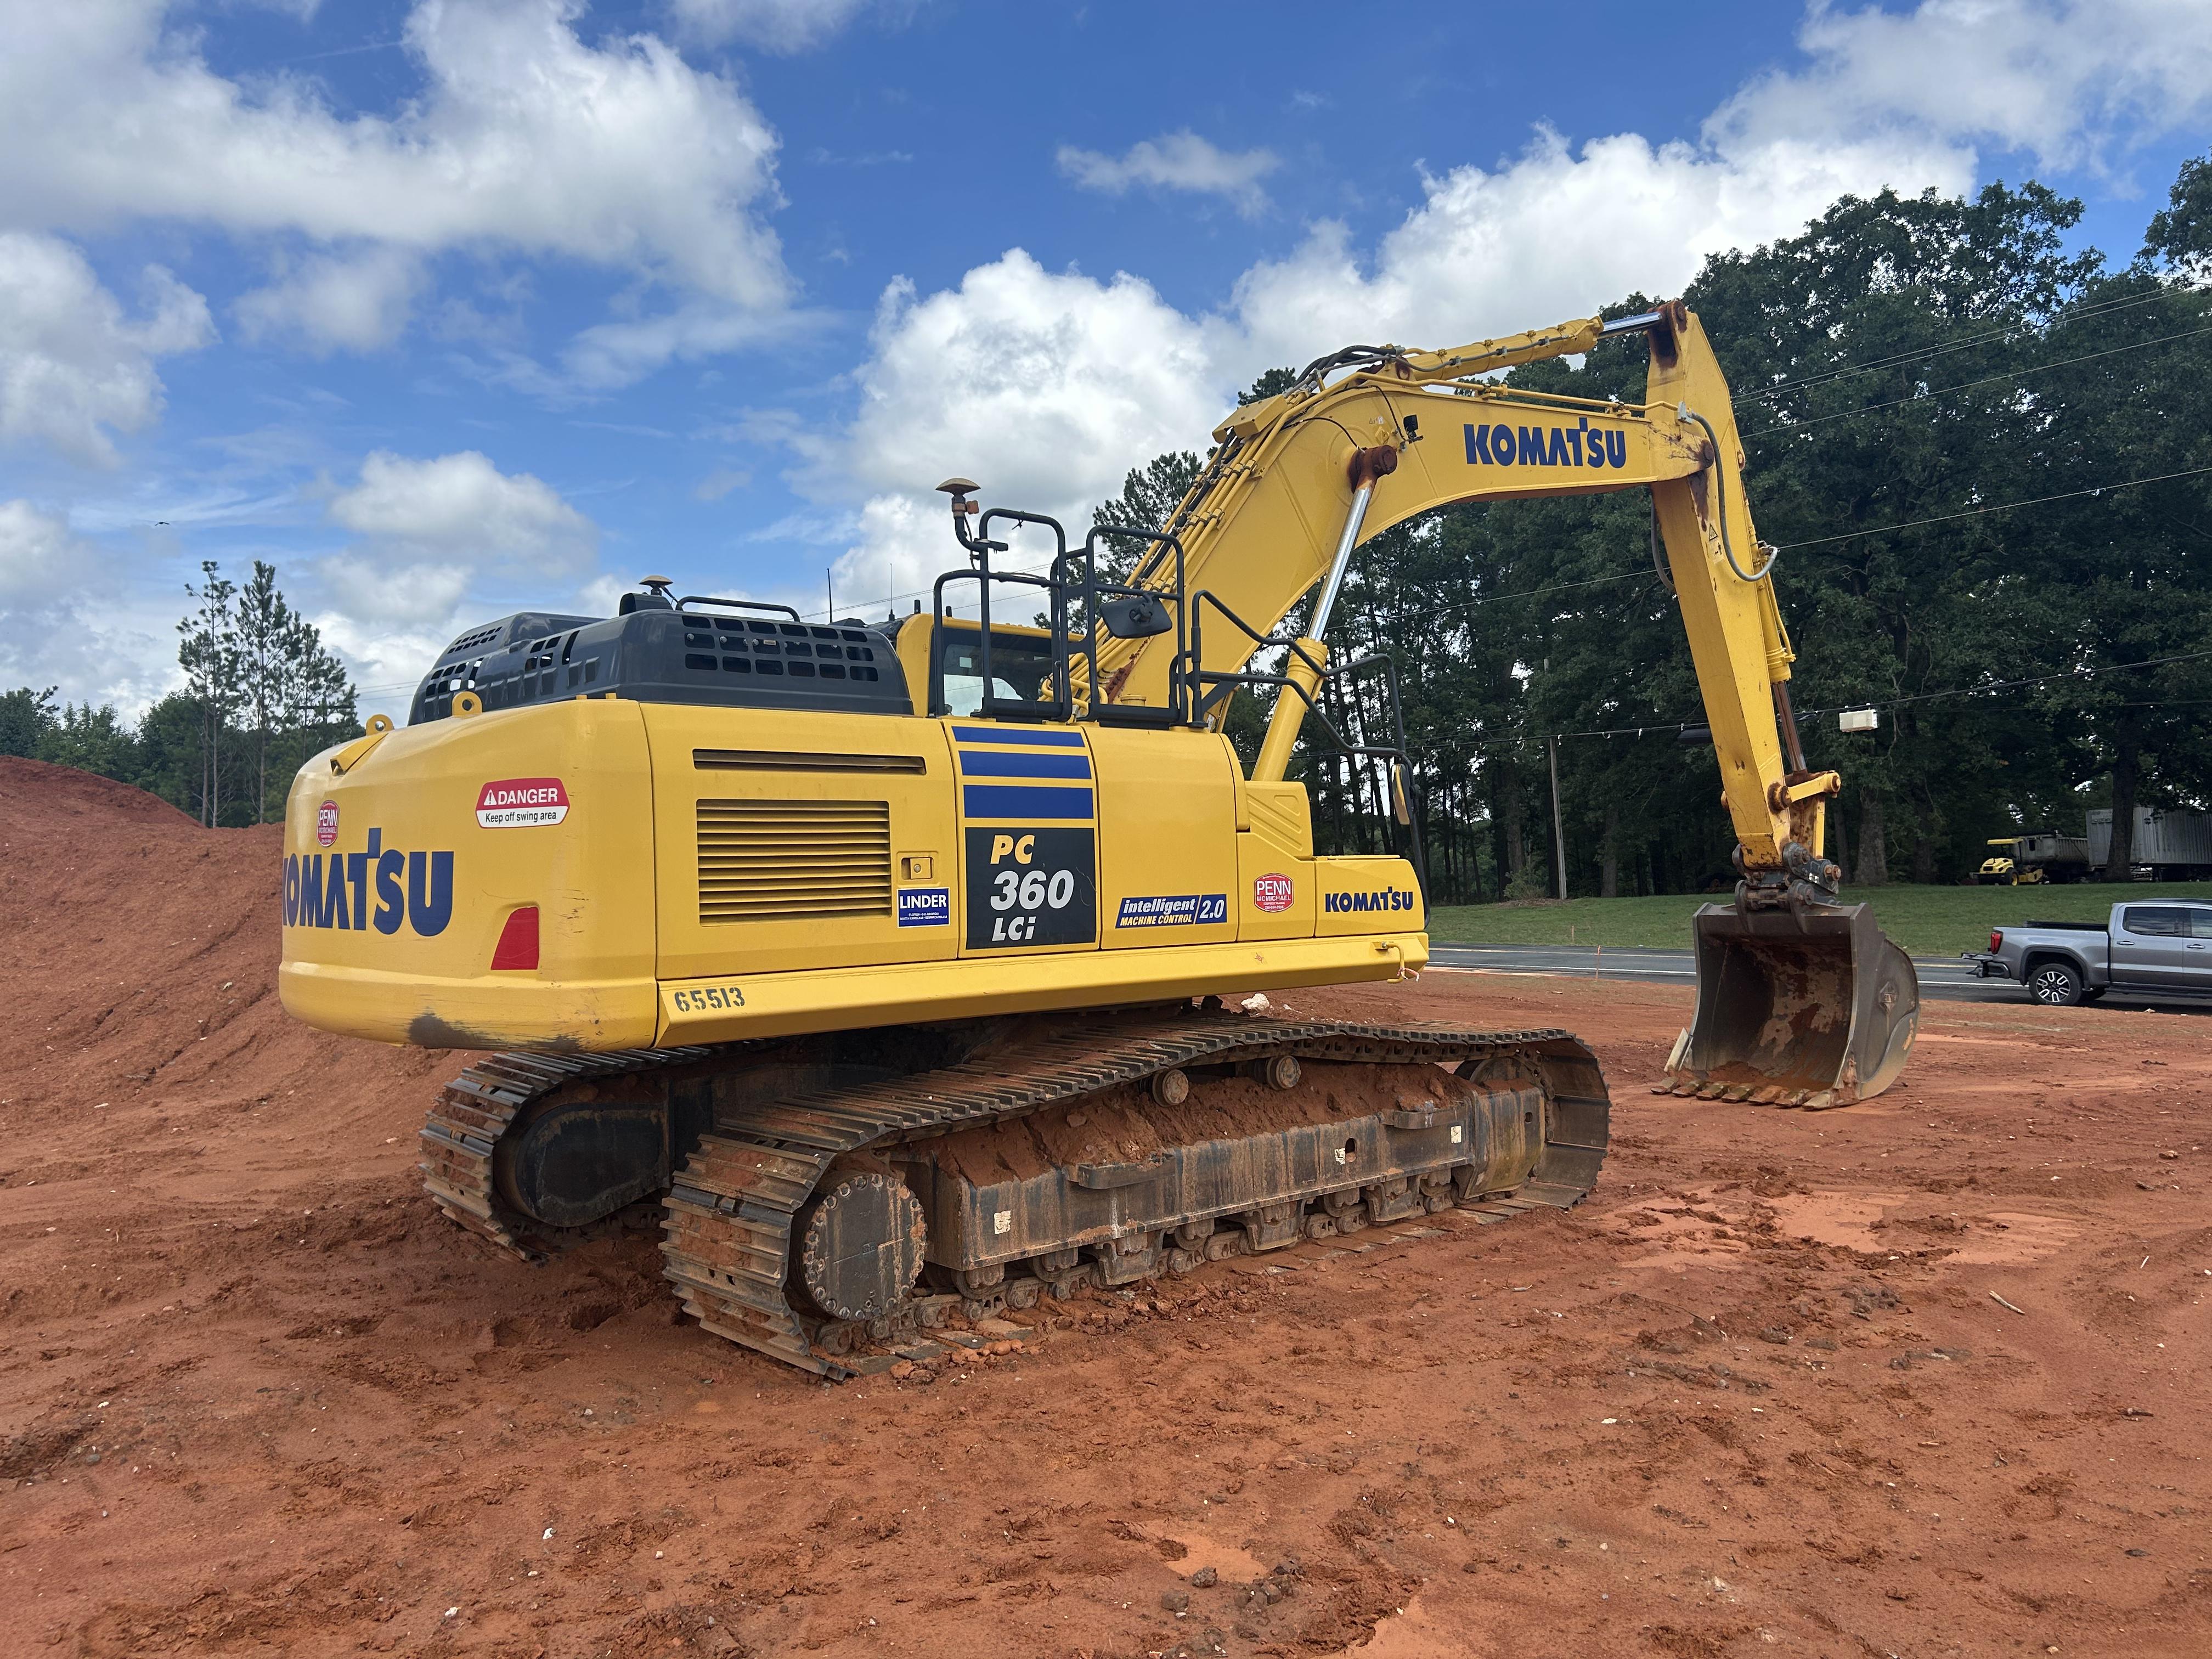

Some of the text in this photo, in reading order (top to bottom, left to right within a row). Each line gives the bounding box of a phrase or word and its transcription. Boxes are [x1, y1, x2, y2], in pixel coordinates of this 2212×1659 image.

[1463, 417, 1626, 469] KOMATSU
[498, 788, 558, 805] DANGER
[319, 809, 338, 826] PENN
[486, 811, 556, 824] Keep off swing area
[990, 834, 1035, 865] PC
[990, 870, 1074, 911] 360
[1256, 880, 1291, 895] PENN
[900, 894, 947, 909] LINDER
[1123, 898, 1195, 915] intelligent
[1325, 886, 1413, 912] KOMATSU
[1199, 899, 1224, 919] 2.0
[991, 916, 1036, 941] LCi
[1120, 913, 1192, 926] MACHINE CONTROL
[674, 987, 746, 1013] 65513
